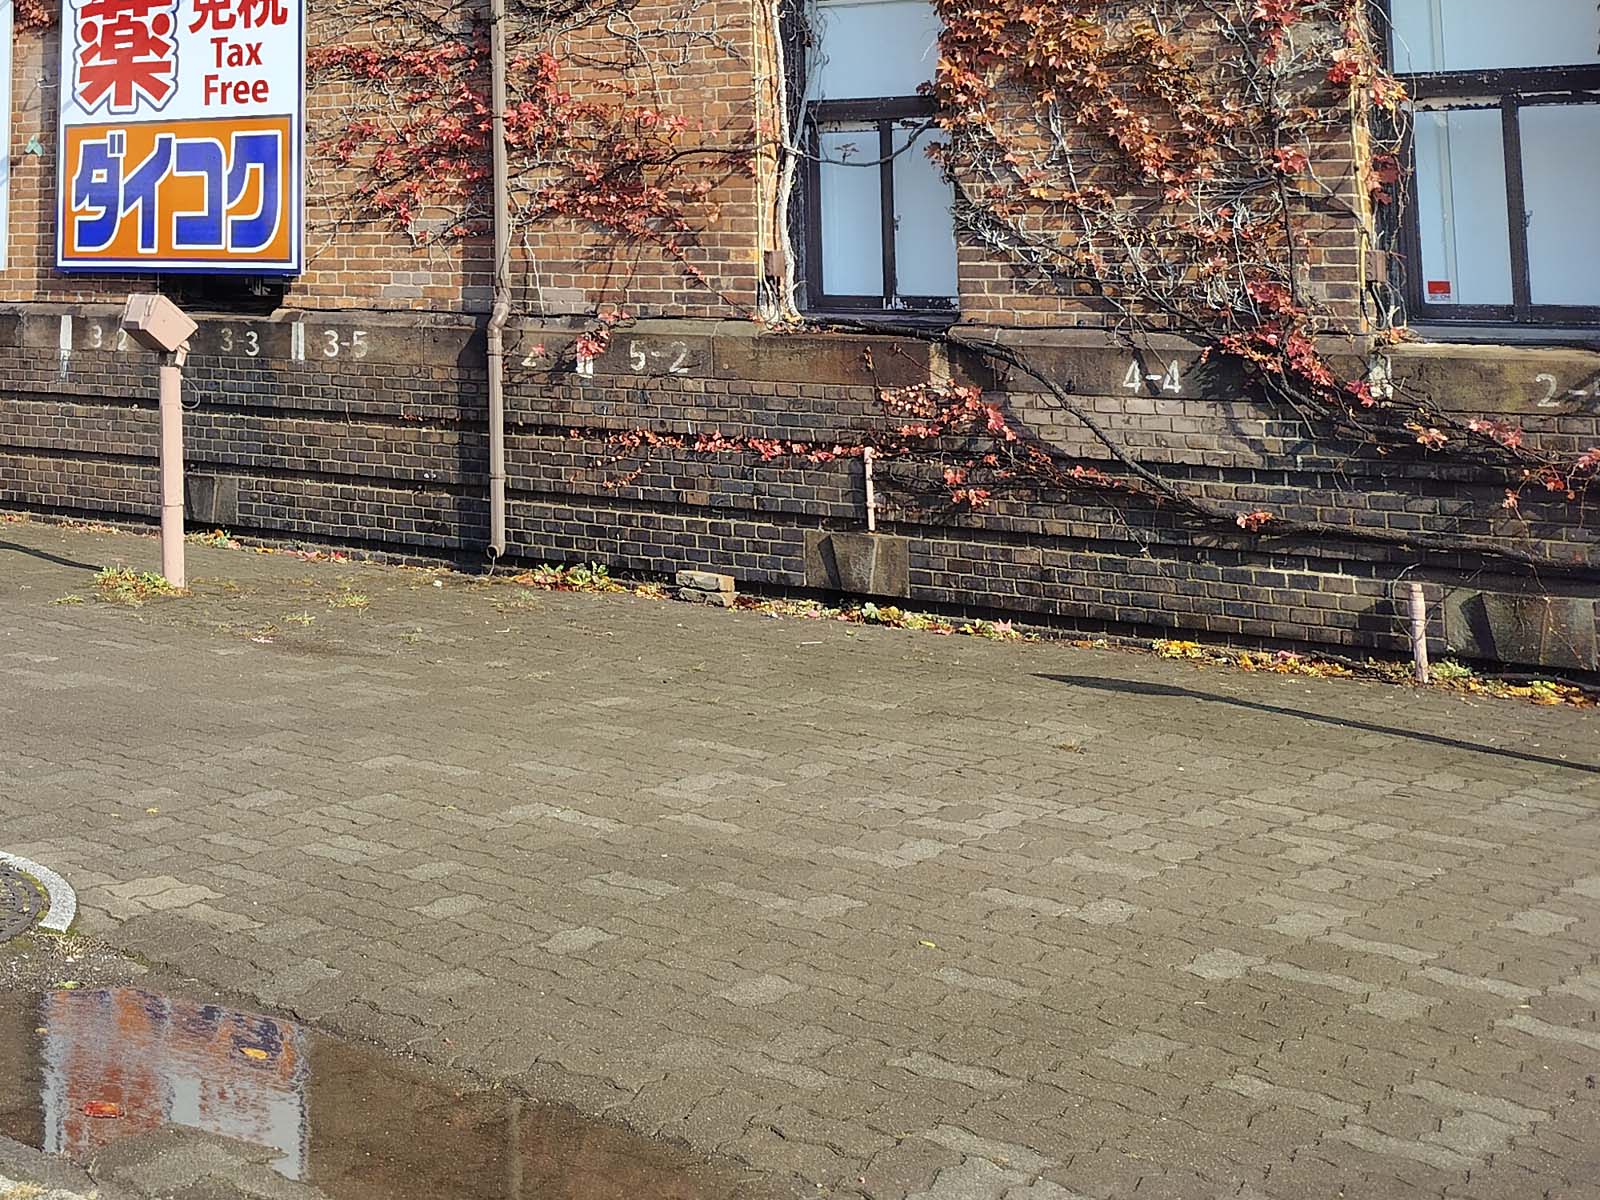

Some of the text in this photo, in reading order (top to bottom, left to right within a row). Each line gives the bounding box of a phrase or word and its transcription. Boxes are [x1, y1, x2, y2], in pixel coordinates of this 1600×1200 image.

[210, 37, 263, 68] Tax
[204, 74, 270, 106] Free
[71, 130, 283, 254] ダイコク
[220, 328, 260, 356] 3-3
[324, 330, 368, 358] 3-5
[1123, 360, 1182, 393] 4-4
